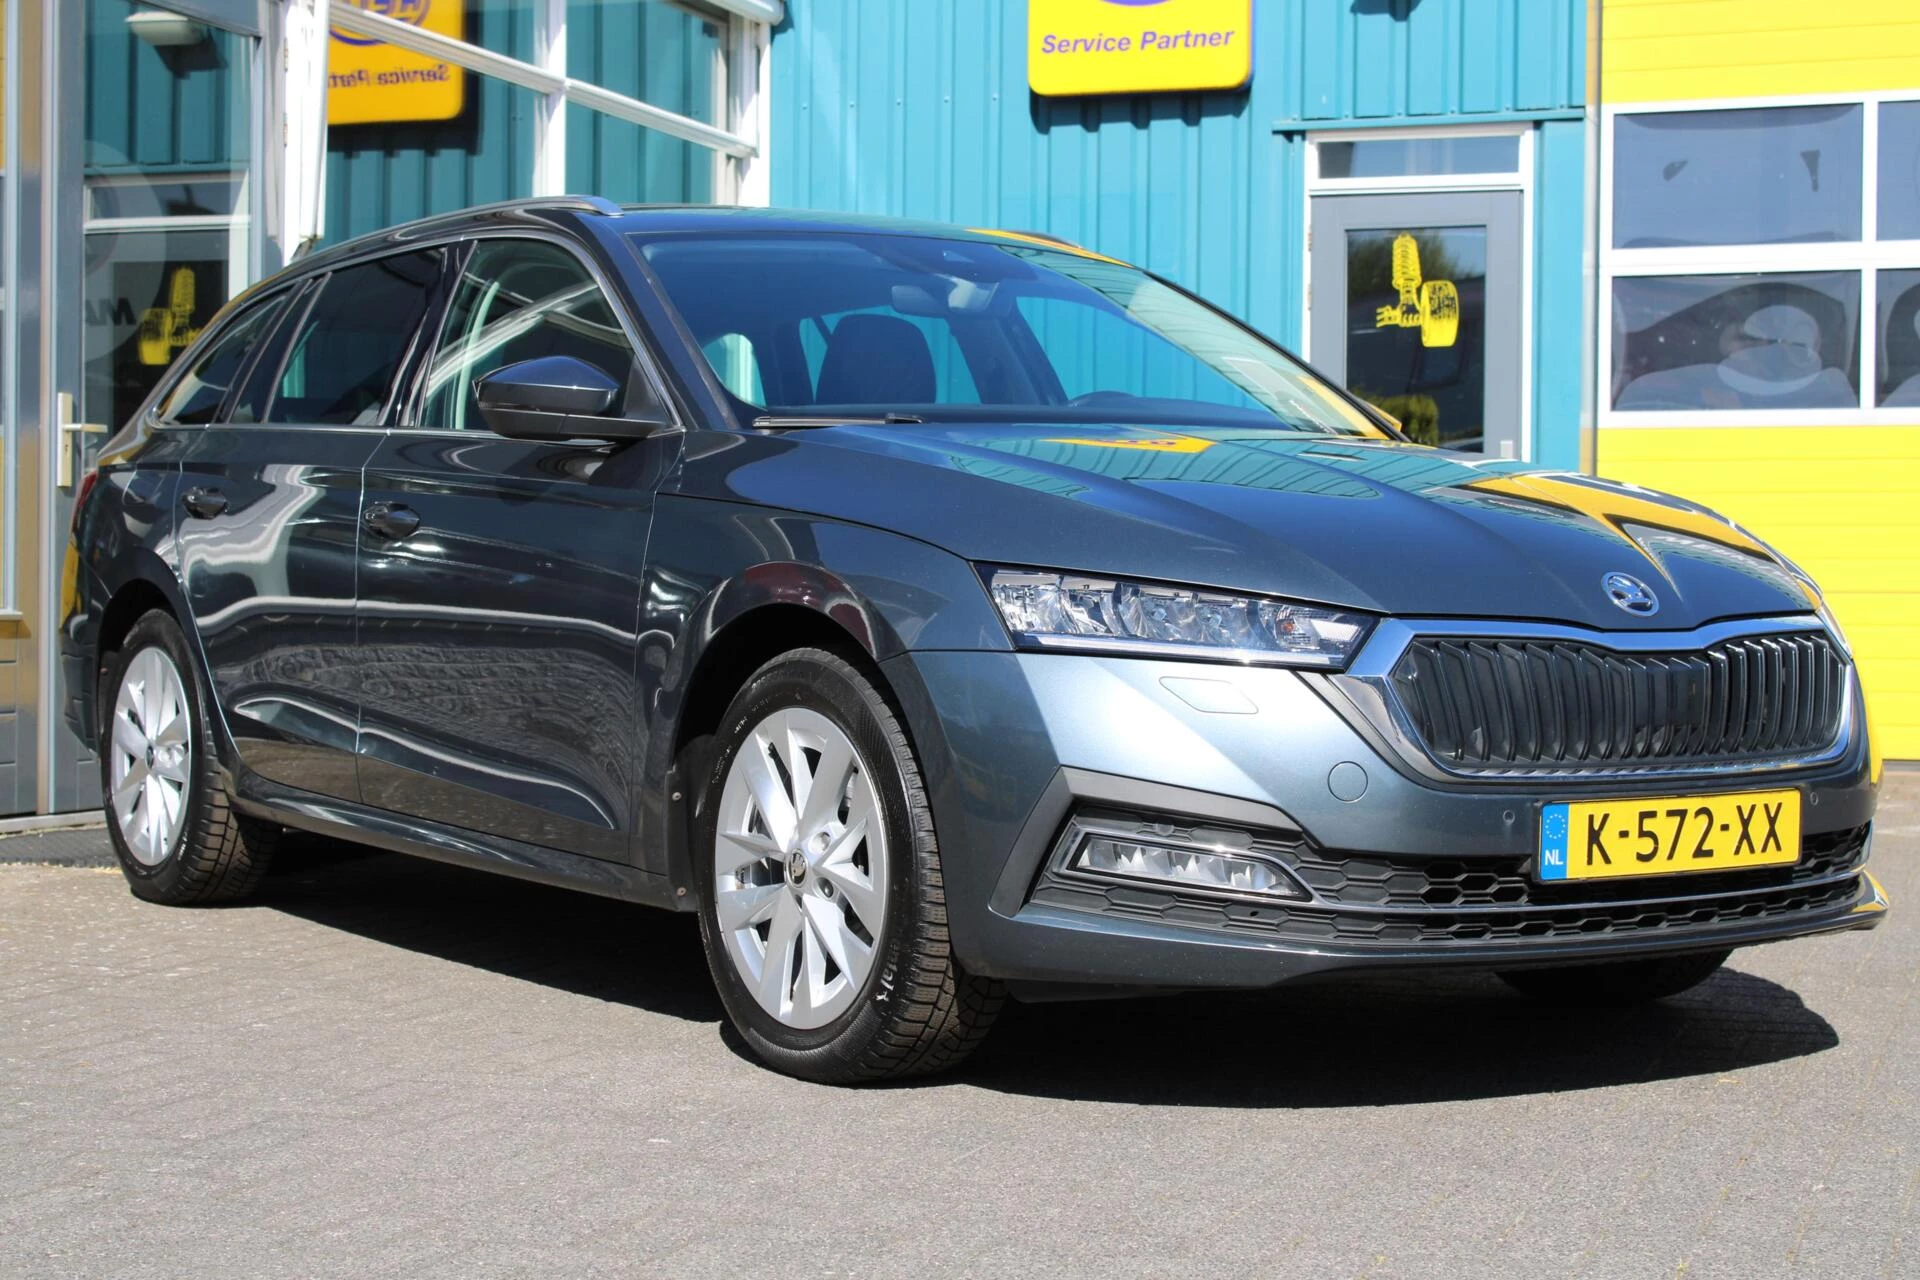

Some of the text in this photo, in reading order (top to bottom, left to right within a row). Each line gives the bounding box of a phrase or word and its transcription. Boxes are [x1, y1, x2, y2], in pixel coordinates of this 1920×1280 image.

[1041, 29, 1236, 54] Service Partner
[1586, 801, 1783, 867] K-572-XX
[1544, 848, 1564, 866] NL
